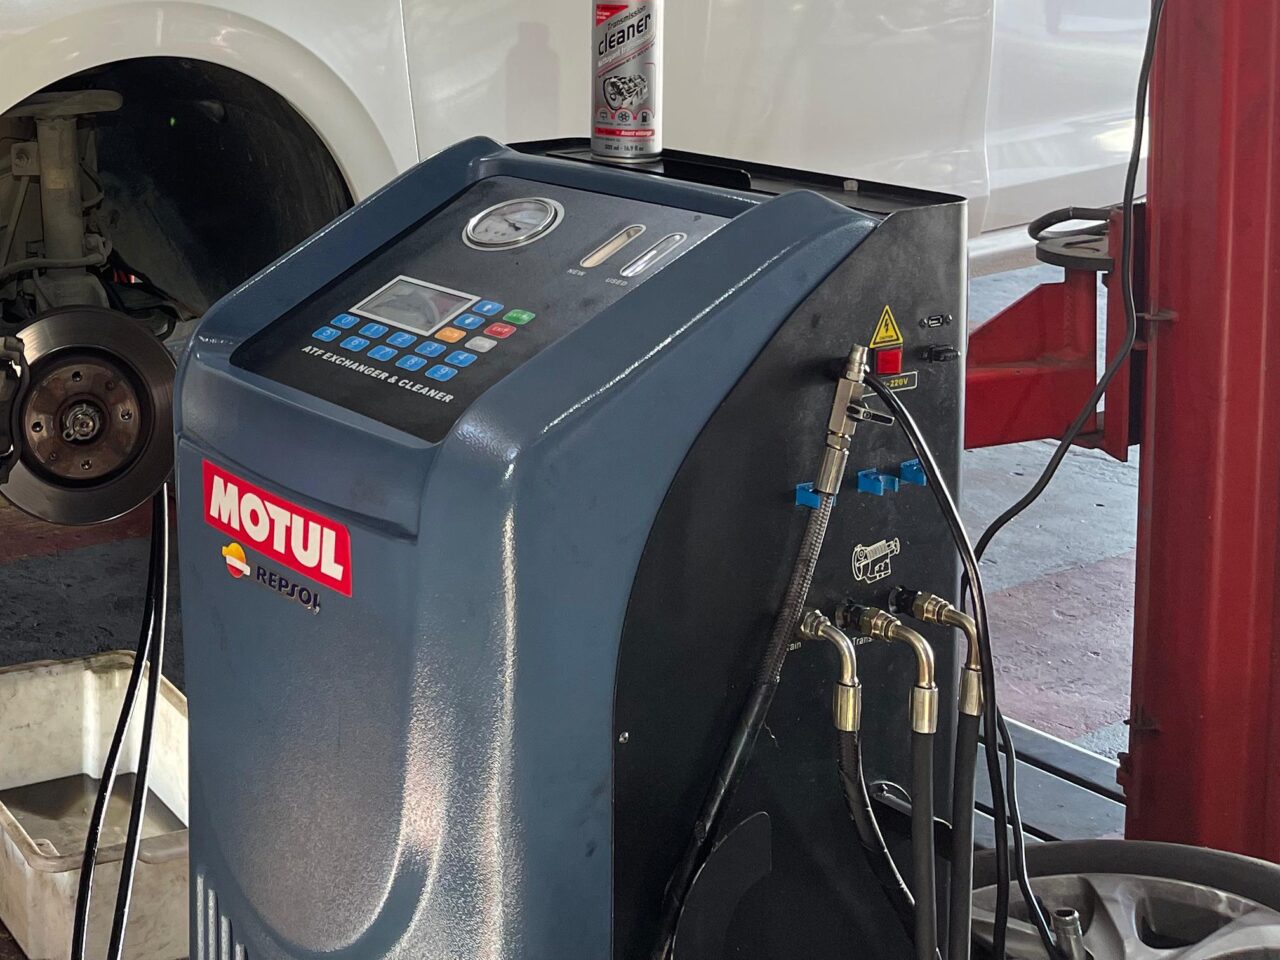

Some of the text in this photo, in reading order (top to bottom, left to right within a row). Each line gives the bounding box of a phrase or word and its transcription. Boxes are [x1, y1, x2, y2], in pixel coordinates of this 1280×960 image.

[598, 13, 651, 56] cleaner
[301, 345, 455, 403] ATF EXCHANGER & CLEANER
[209, 474, 344, 582] MOTUL
